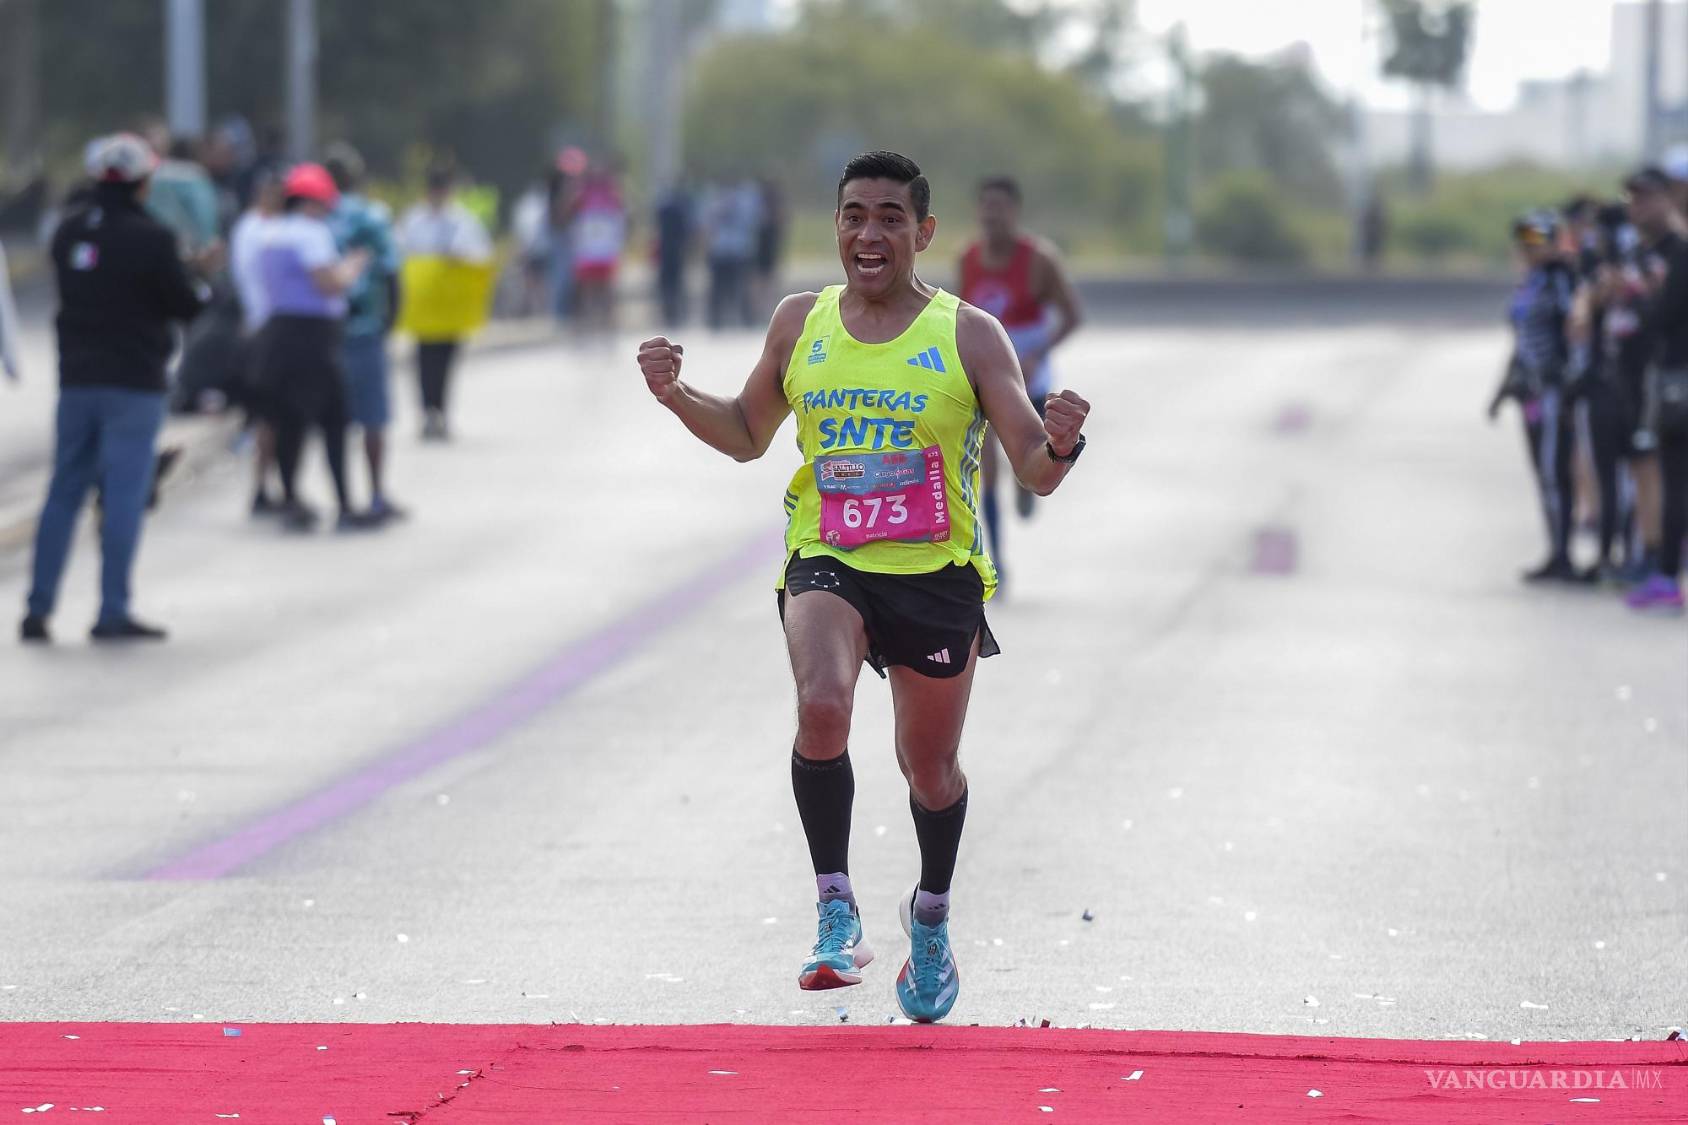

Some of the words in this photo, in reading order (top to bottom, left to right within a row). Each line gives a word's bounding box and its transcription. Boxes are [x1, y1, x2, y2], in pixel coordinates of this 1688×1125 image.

[812, 339, 824, 353] 5
[803, 388, 929, 414] PANTERAS
[819, 416, 915, 450] SNTE
[929, 461, 945, 524] Medalla
[843, 494, 908, 528] 673
